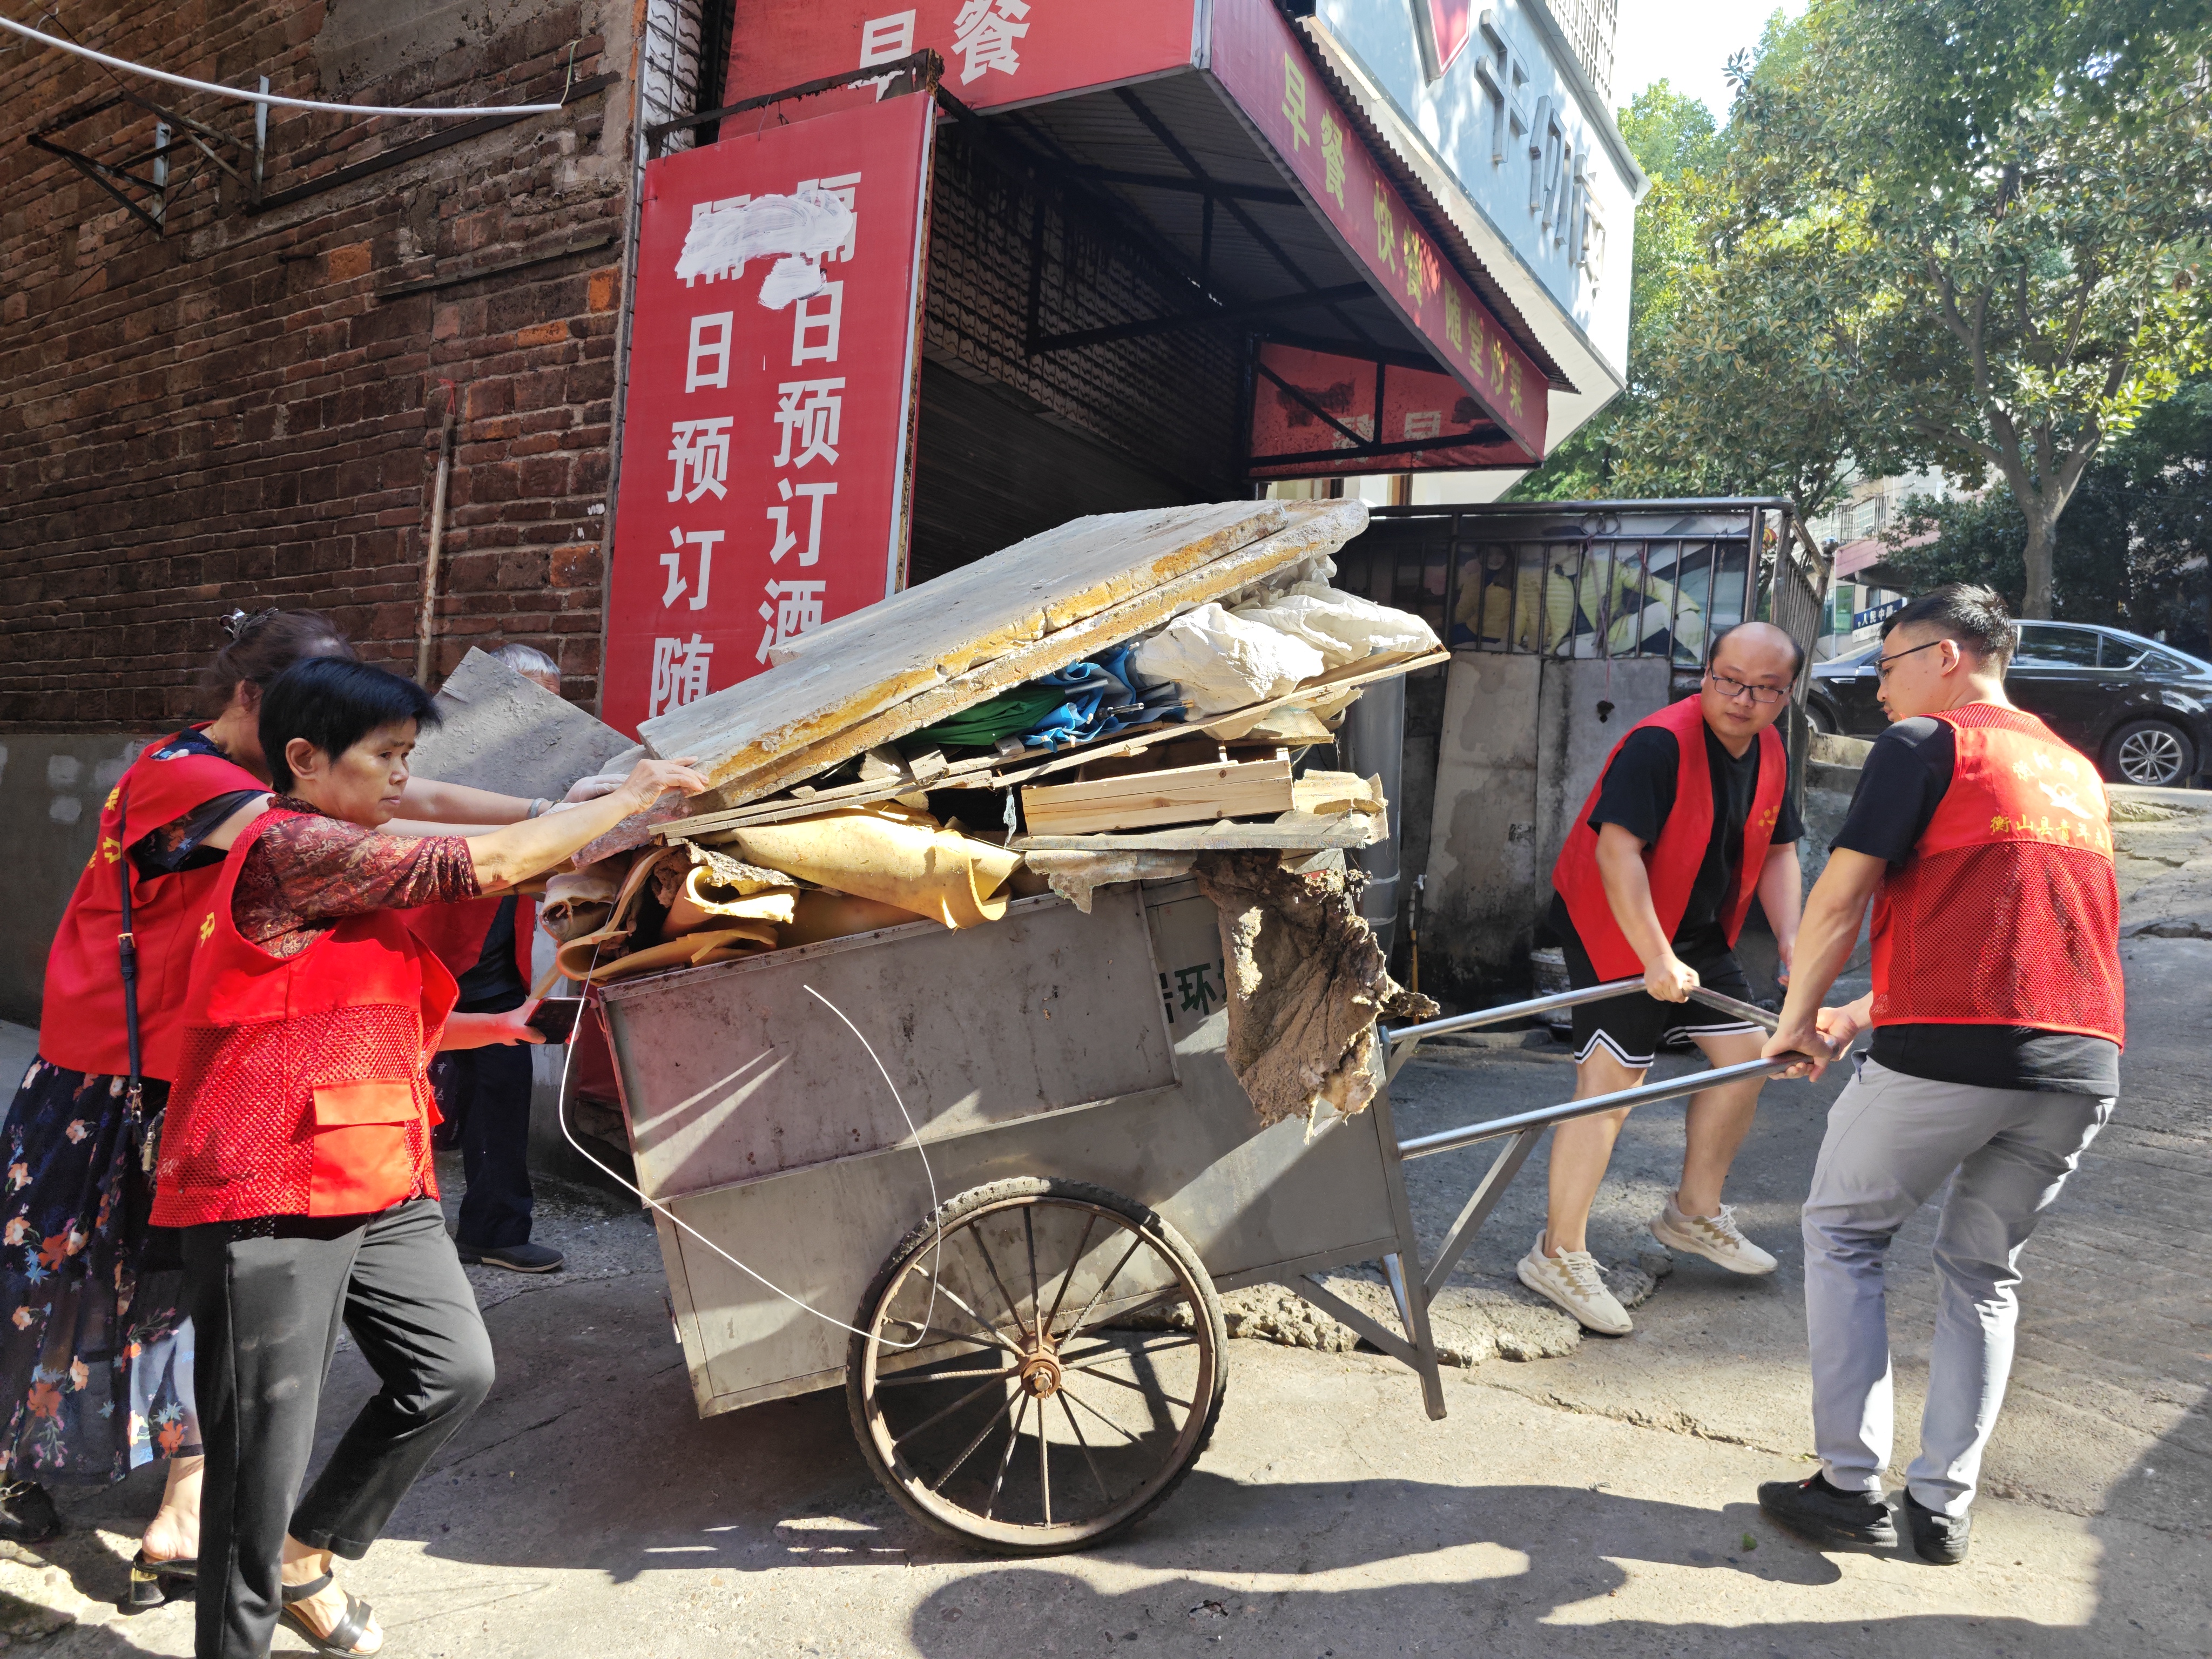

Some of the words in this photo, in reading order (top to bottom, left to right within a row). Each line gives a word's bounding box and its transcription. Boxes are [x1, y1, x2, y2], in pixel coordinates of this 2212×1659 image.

[847, 0, 1031, 103] 早餐
[1282, 51, 1346, 211] 早餐
[1373, 181, 1422, 308] 快餐
